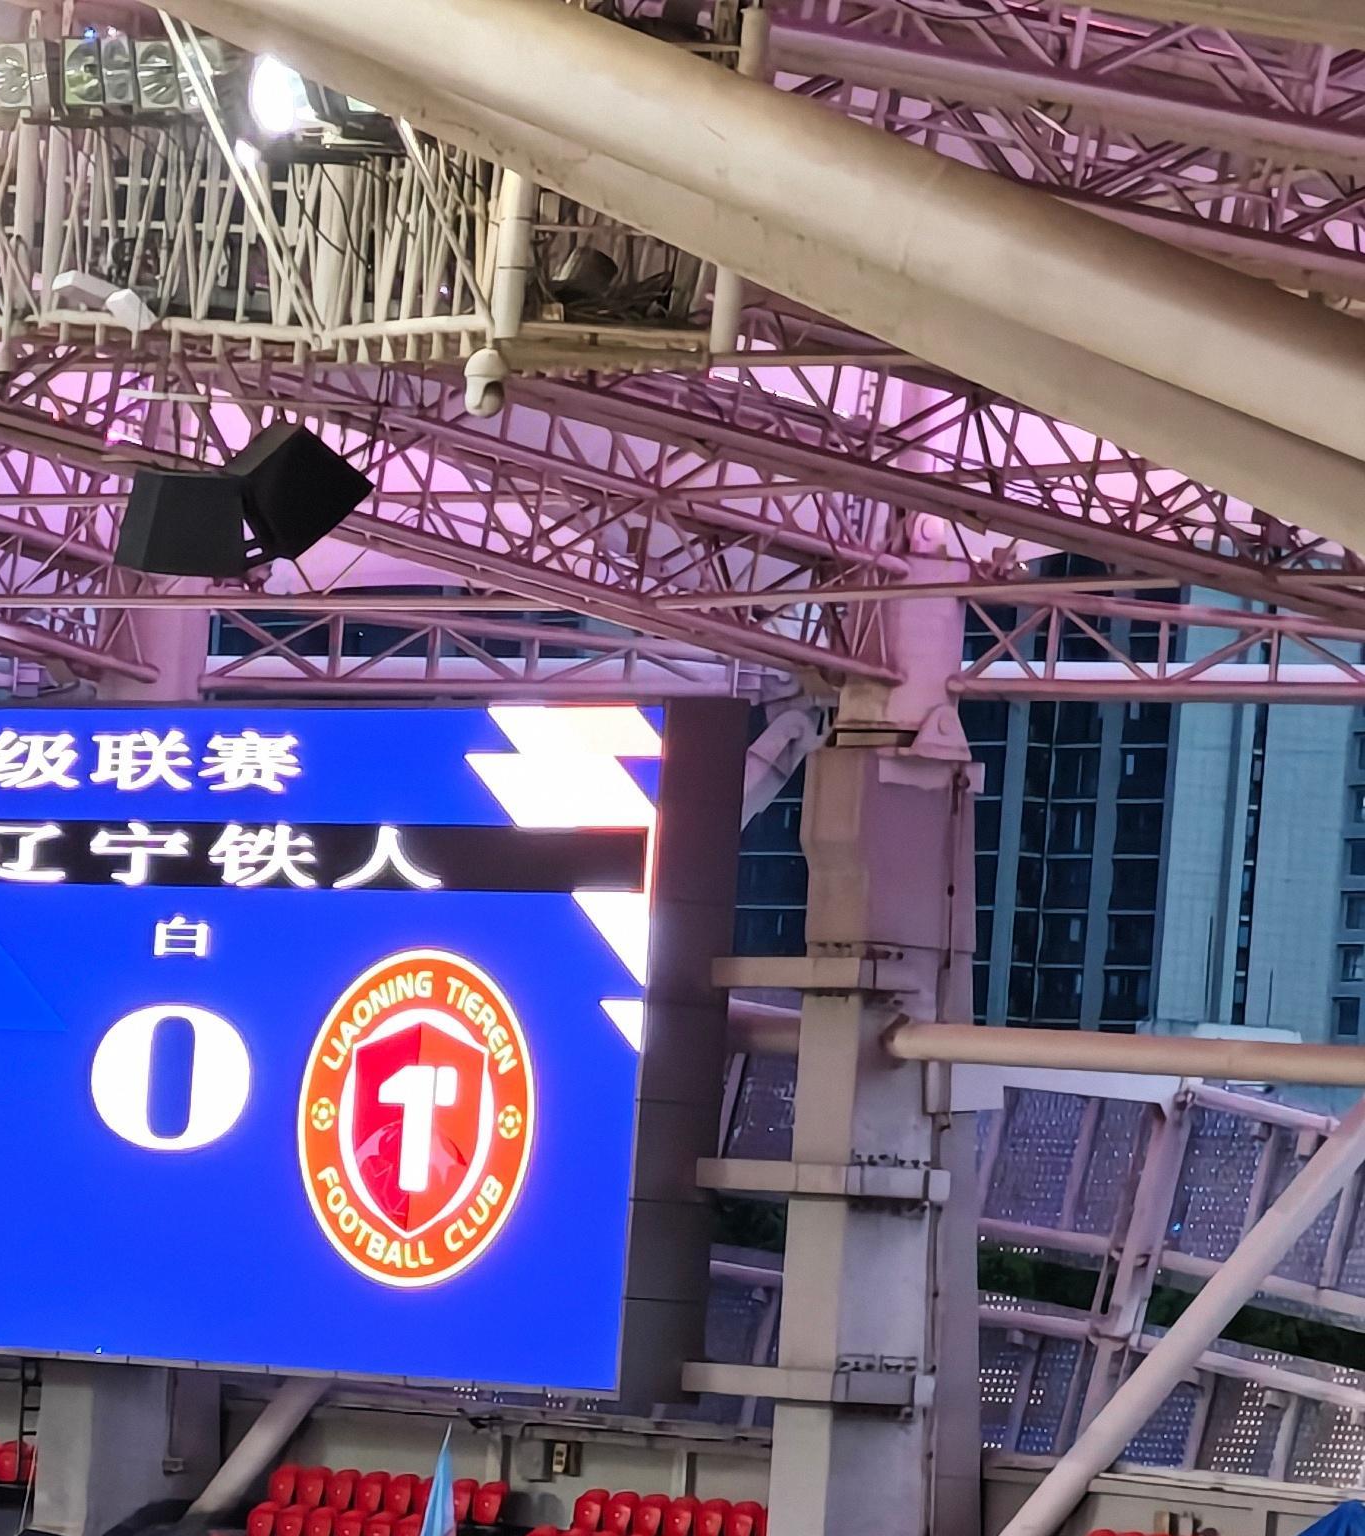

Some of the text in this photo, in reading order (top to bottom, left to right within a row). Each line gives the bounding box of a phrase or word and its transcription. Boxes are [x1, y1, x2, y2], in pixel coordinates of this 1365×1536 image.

[153, 914, 212, 958] 白
[322, 970, 518, 1075] LIAONING TIEREN
[90, 1002, 253, 1152] 0
[317, 1165, 504, 1268] FOOTBALL CLUB
